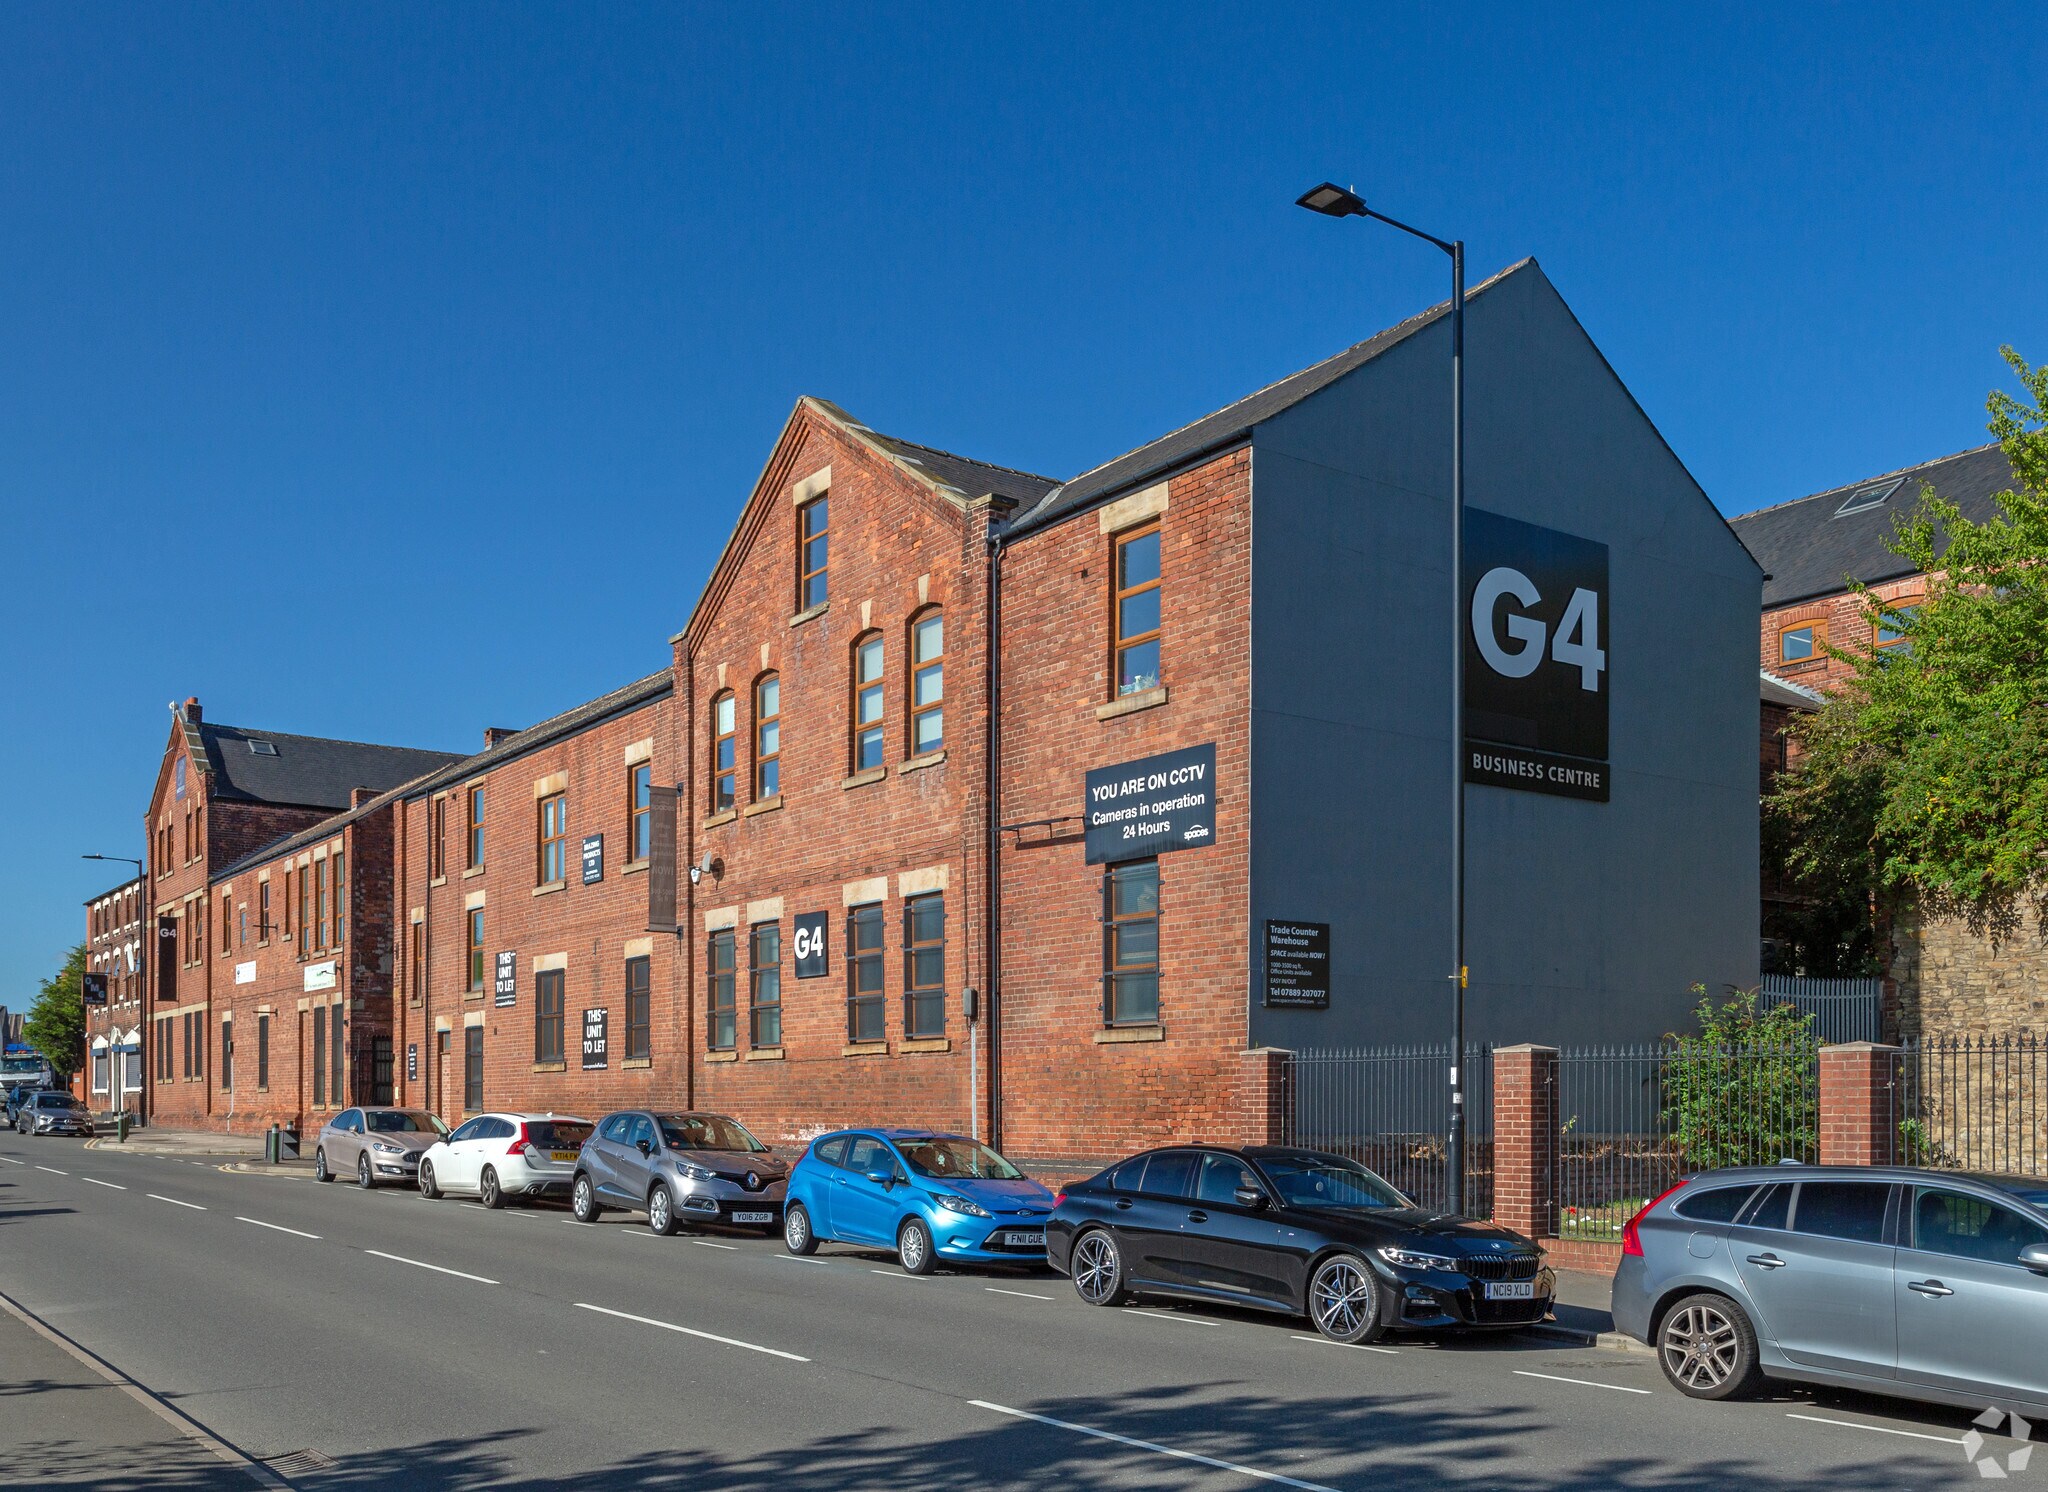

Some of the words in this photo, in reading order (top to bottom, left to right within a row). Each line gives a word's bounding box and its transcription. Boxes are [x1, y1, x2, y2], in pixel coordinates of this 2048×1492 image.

[1472, 566, 1606, 692] G4
[1472, 753, 1544, 780] BUSINESS
[1548, 766, 1600, 788] CENTRE
[1092, 783, 1118, 802] YOU
[1120, 777, 1145, 796] ARE
[1147, 772, 1167, 790] ON
[1169, 764, 1206, 786] CCTV
[1092, 806, 1137, 826] Cameras
[1139, 803, 1150, 817] in
[1152, 793, 1205, 816] operation
[1122, 824, 1136, 840] 24
[1138, 820, 1171, 836] Hours
[1184, 827, 1209, 841] spaces
[160, 928, 176, 938] G4
[1270, 925, 1290, 934] Trade
[1291, 926, 1319, 937] Counter
[794, 926, 824, 960] G4
[1270, 936, 1309, 946] Warehouse
[499, 952, 511, 965] THIS
[498, 966, 512, 979] UNIT
[496, 981, 504, 993] TO
[504, 980, 514, 992] LET
[1270, 988, 1280, 996] Tel
[1280, 988, 1301, 997] 07889
[1302, 990, 1326, 998] 207077
[587, 1008, 602, 1022] THIS
[586, 1024, 602, 1038] UNIT
[583, 1040, 592, 1054] TO
[594, 1040, 606, 1053] LET
[737, 1212, 753, 1222] YO16
[754, 1212, 768, 1222] ZGB
[1011, 1234, 1026, 1244] FN11
[1028, 1234, 1044, 1244] GUE
[1493, 1284, 1512, 1296] NC19
[1514, 1284, 1530, 1296] XLD
